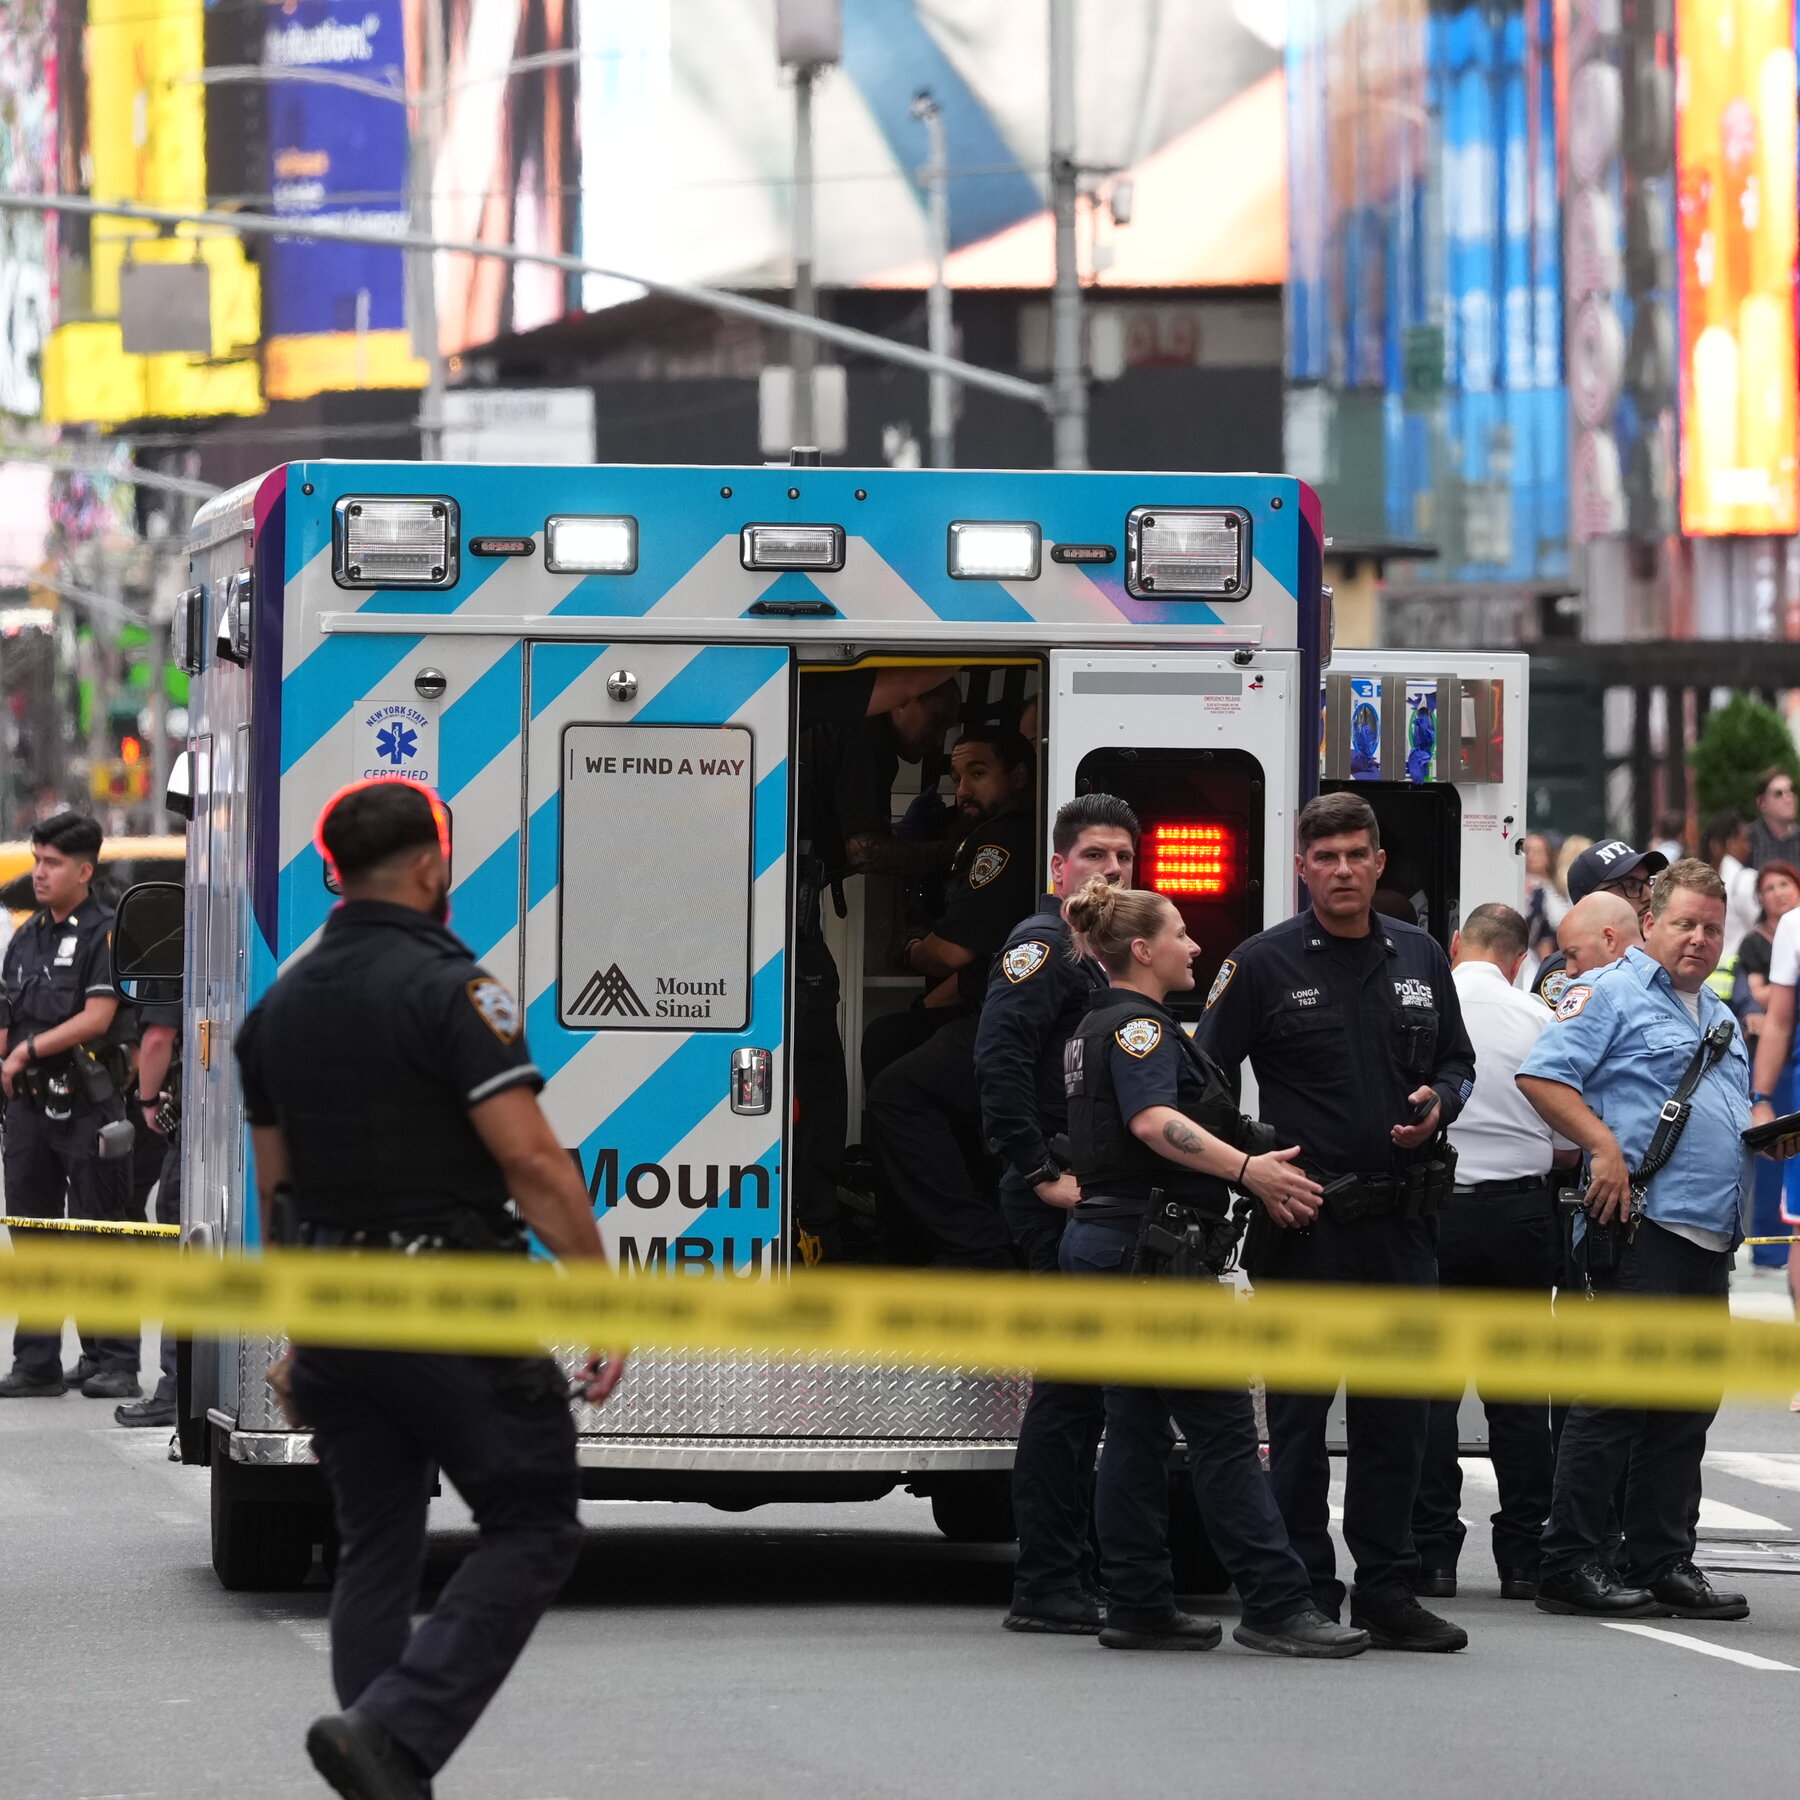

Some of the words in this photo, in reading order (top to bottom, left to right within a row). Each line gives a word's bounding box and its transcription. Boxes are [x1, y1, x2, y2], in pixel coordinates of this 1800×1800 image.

[366, 710, 383, 727] NEW
[383, 706, 407, 715] YORK
[407, 708, 428, 728] STATE
[364, 769, 429, 781] CERTIFIED
[585, 757, 617, 773] WE
[622, 757, 673, 774] FIND
[677, 758, 694, 775] A
[699, 759, 745, 776] WAY
[1019, 969, 1030, 978] NEW
[1029, 958, 1042, 970] YORK
[655, 977, 727, 996] Mount
[1291, 988, 1320, 999] LONGA
[1394, 982, 1433, 999] POLICE
[655, 998, 711, 1018] Sinai
[1298, 997, 1317, 1006] 7623
[1064, 1039, 1084, 1075] NYPD
[564, 1148, 780, 1210] Moun
[74, 1224, 99, 1233] CRIME
[101, 1226, 125, 1235] SCENE
[133, 1229, 144, 1238] DO
[145, 1230, 161, 1238] NOT
